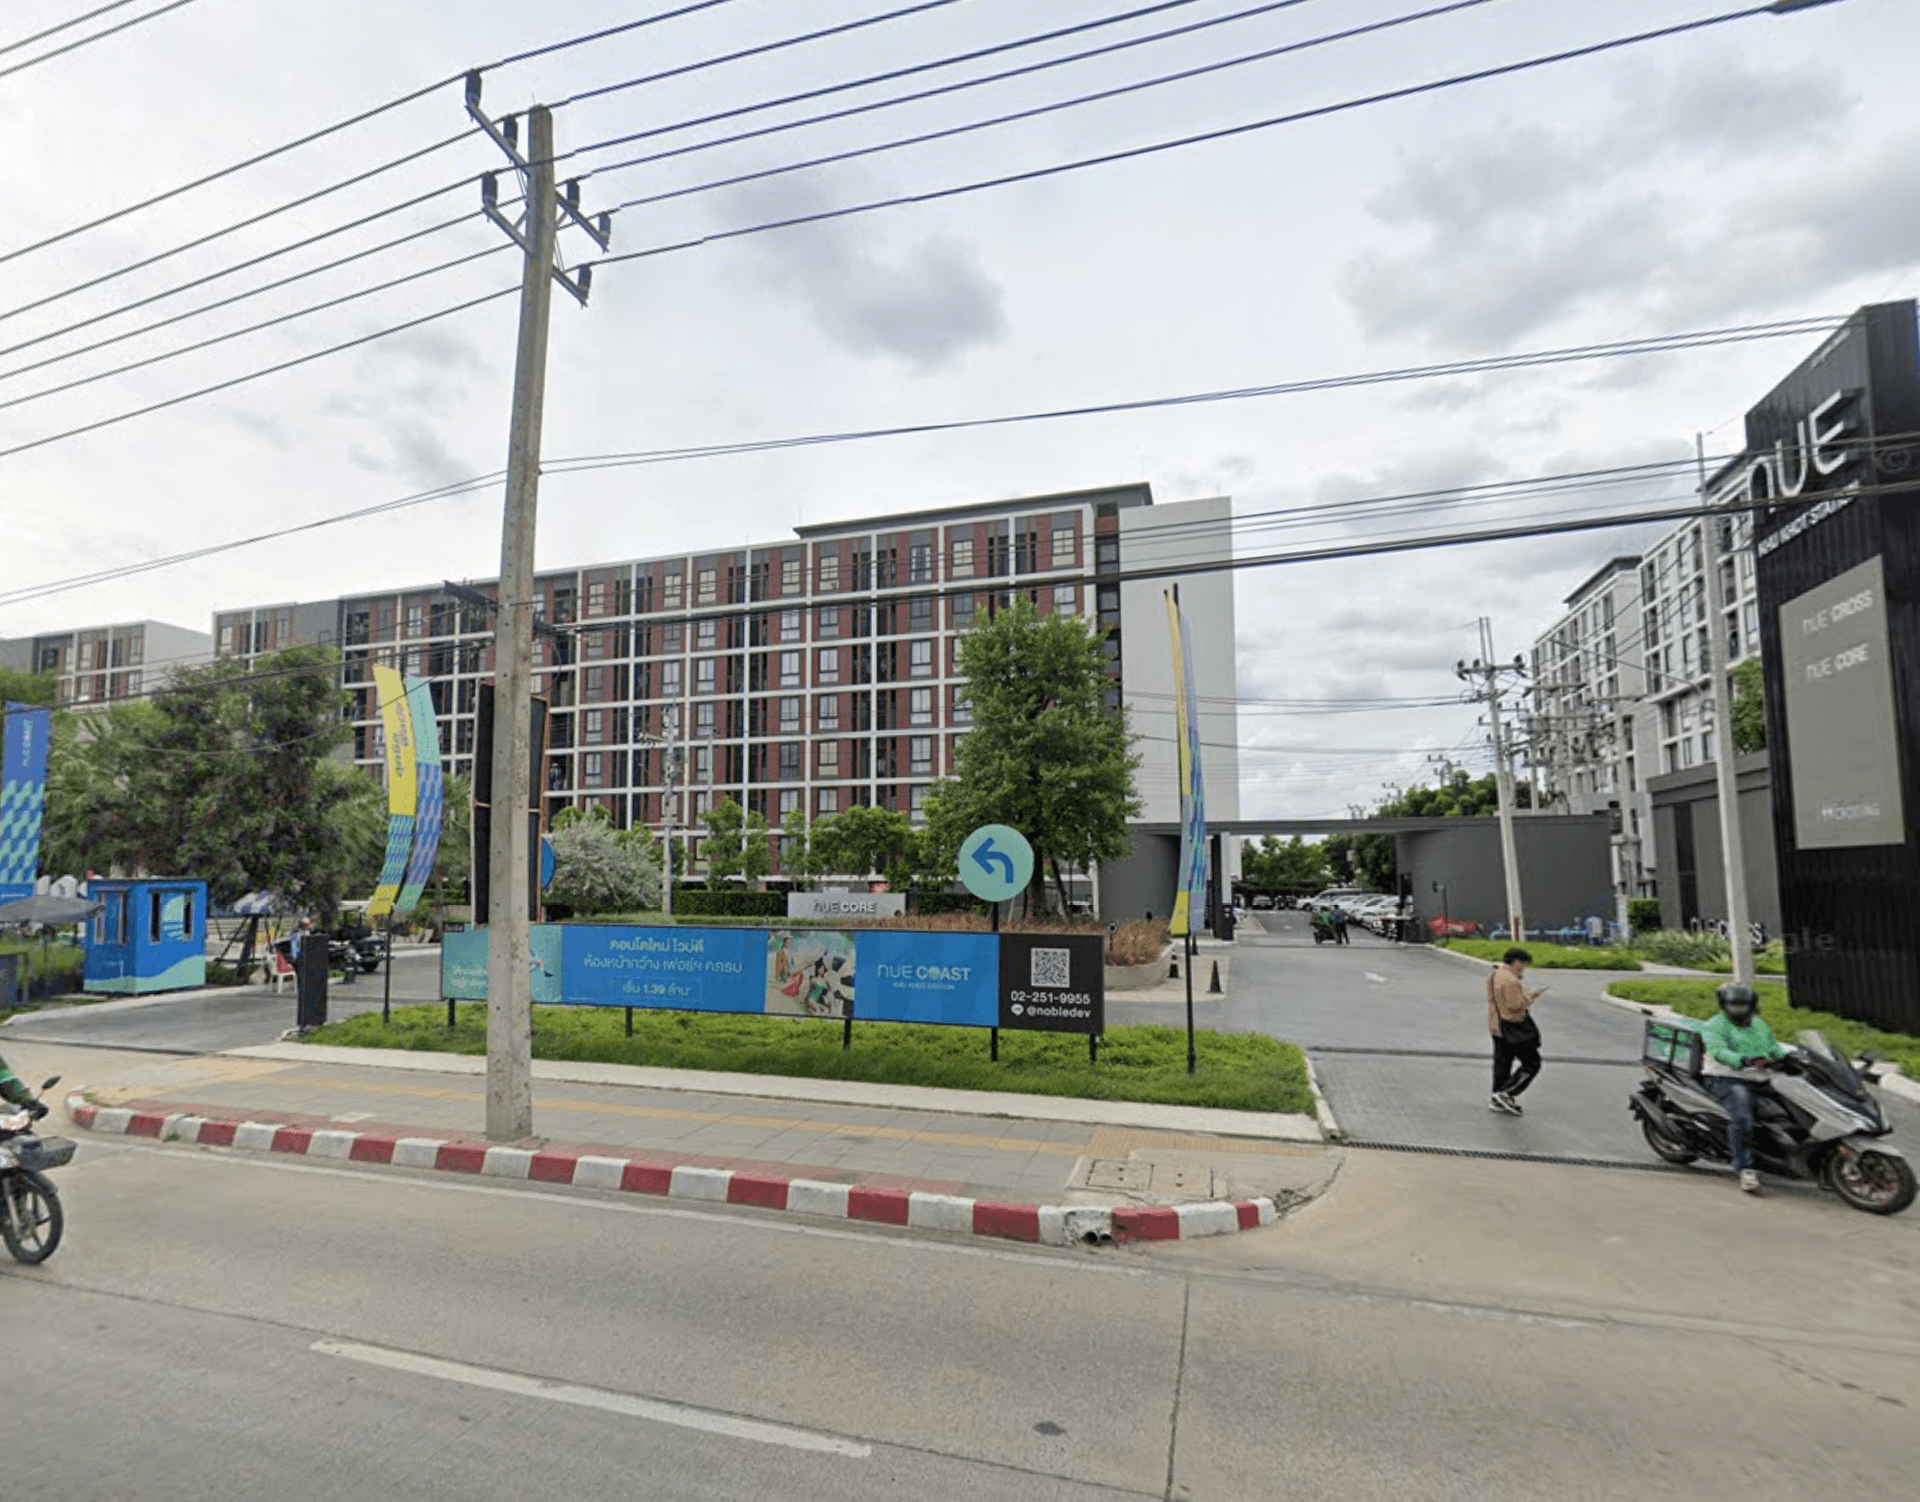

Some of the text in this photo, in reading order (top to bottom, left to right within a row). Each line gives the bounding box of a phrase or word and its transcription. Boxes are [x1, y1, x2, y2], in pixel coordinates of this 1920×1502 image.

[841, 900, 877, 913] CORE
[916, 966, 972, 981] COAST
[642, 983, 665, 994] 1.39
[1010, 990, 1091, 1005] 02-251-9955
[1027, 1006, 1092, 1018] @nobledev
